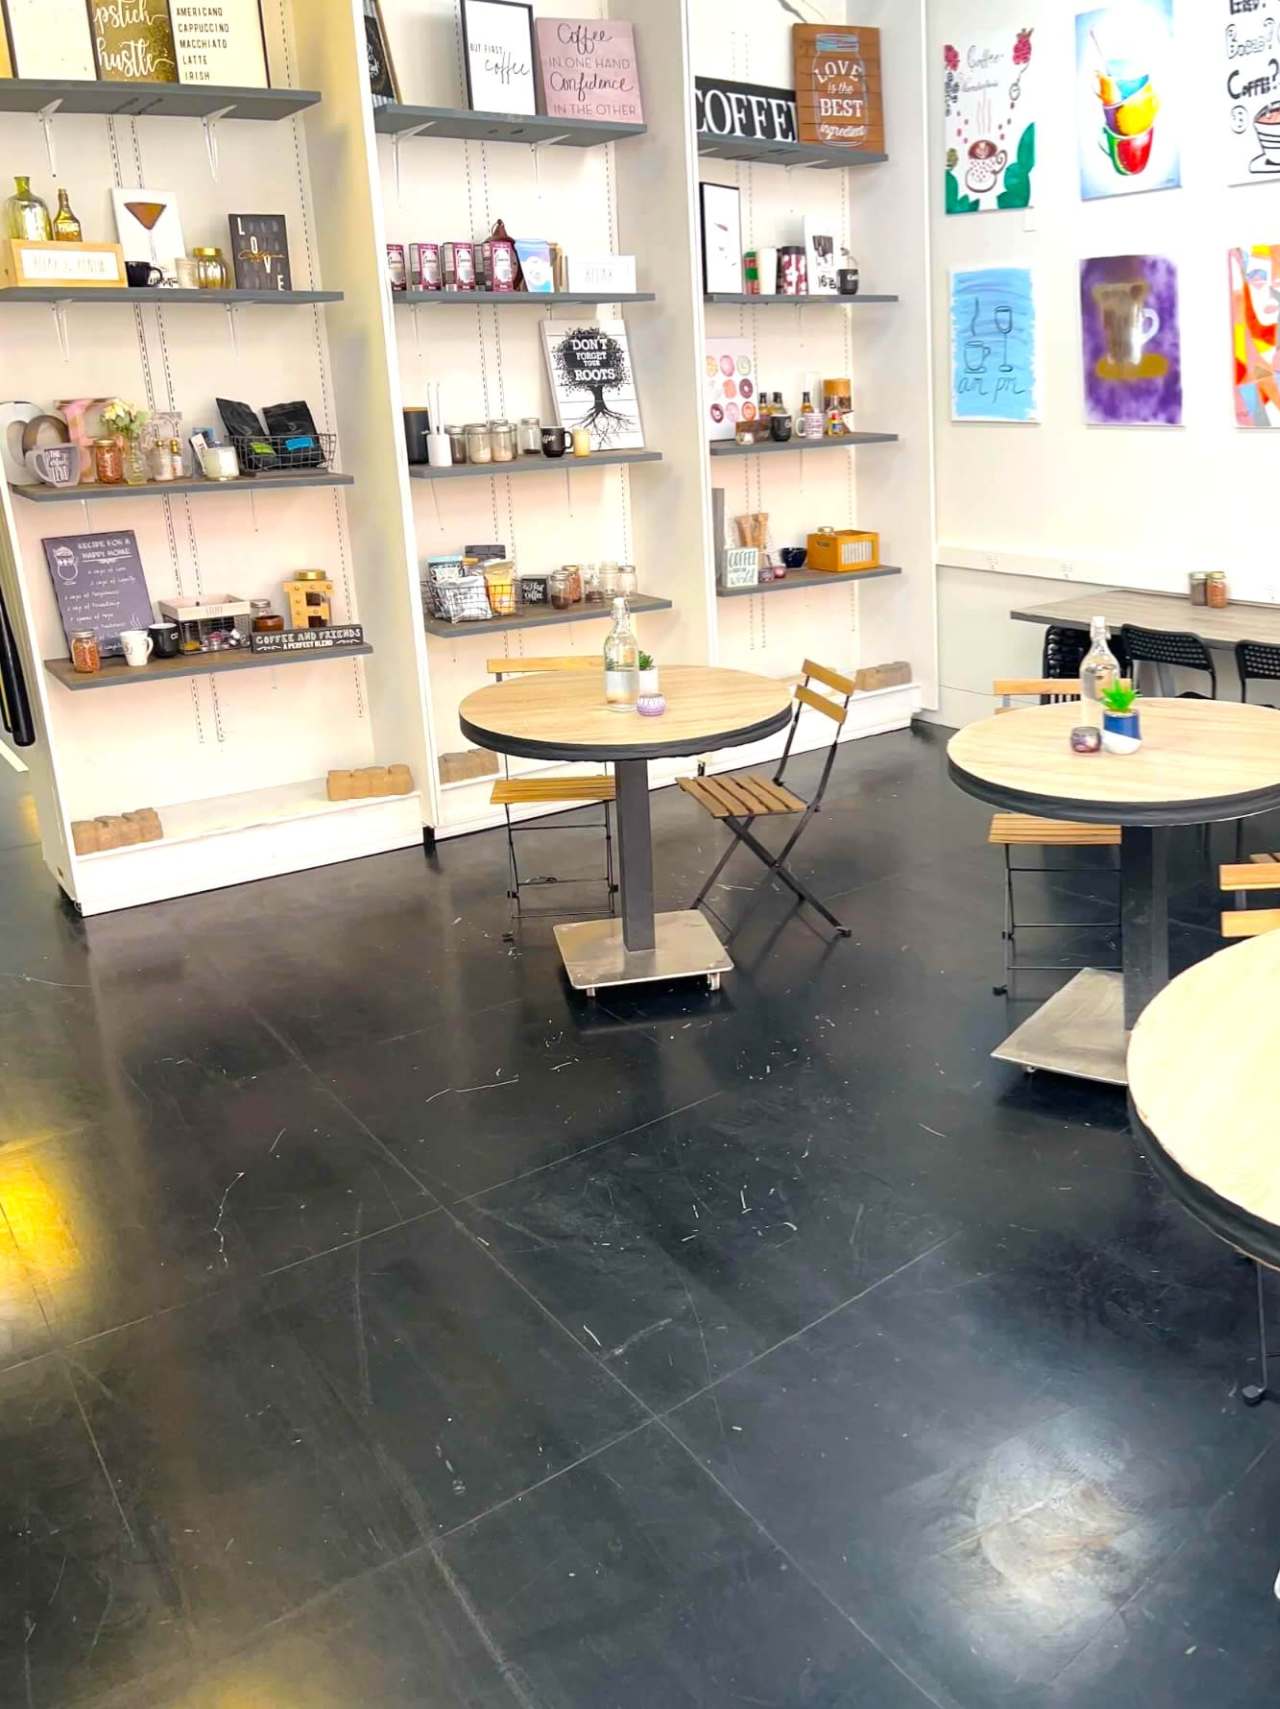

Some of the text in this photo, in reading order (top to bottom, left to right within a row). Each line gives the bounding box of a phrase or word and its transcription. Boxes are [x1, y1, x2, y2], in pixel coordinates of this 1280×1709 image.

[176, 7, 224, 17] AMERICANO
[178, 23, 230, 33] CAPPUCCINO
[179, 39, 228, 49] MACCHIATO
[557, 22, 613, 55] Coffee
[96, 37, 174, 77] hustle
[183, 55, 208, 65] LATTE
[549, 57, 632, 70] IN ONE HAND
[485, 51, 530, 85] coffee
[814, 60, 863, 84] LOVE
[185, 71, 210, 81] IRISH
[550, 71, 634, 101] Confidence
[838, 81, 854, 94] the
[553, 104, 636, 116] IN THE OTHER
[820, 98, 863, 117] BEST
[571, 336, 608, 351] DON'T
[576, 351, 607, 361] FORGET
[574, 368, 616, 381] ROOTS
[255, 628, 361, 645] COFFEE AND FRIENDS
[288, 641, 314, 650] PERFECT
